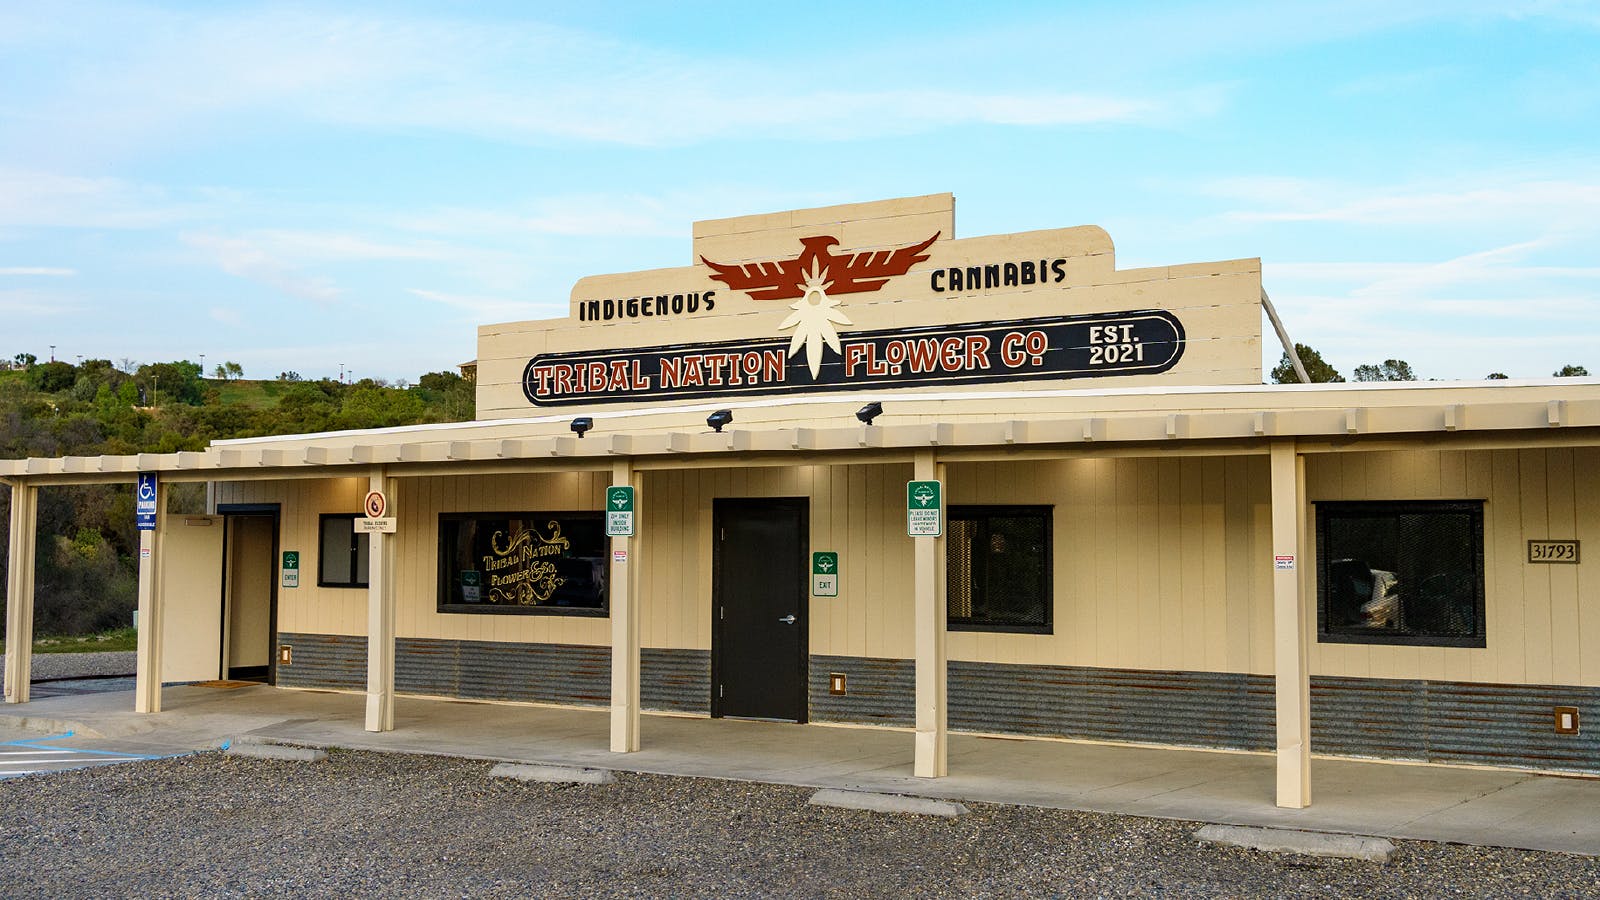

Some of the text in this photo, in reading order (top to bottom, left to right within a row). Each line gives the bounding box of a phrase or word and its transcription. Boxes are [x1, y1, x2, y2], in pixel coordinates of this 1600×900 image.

[931, 259, 1067, 292] CANNABIS
[579, 291, 716, 321] INDIGENOUS
[1089, 324, 1139, 344] EST.
[532, 358, 650, 396] TRIBAL
[659, 349, 787, 388] NATION
[845, 335, 991, 377] FLOWER
[1089, 343, 1144, 365] 2021
[482, 544, 562, 571] TRIBAL NATION
[1533, 545, 1574, 559] 31793
[491, 569, 530, 586] FLOWER
